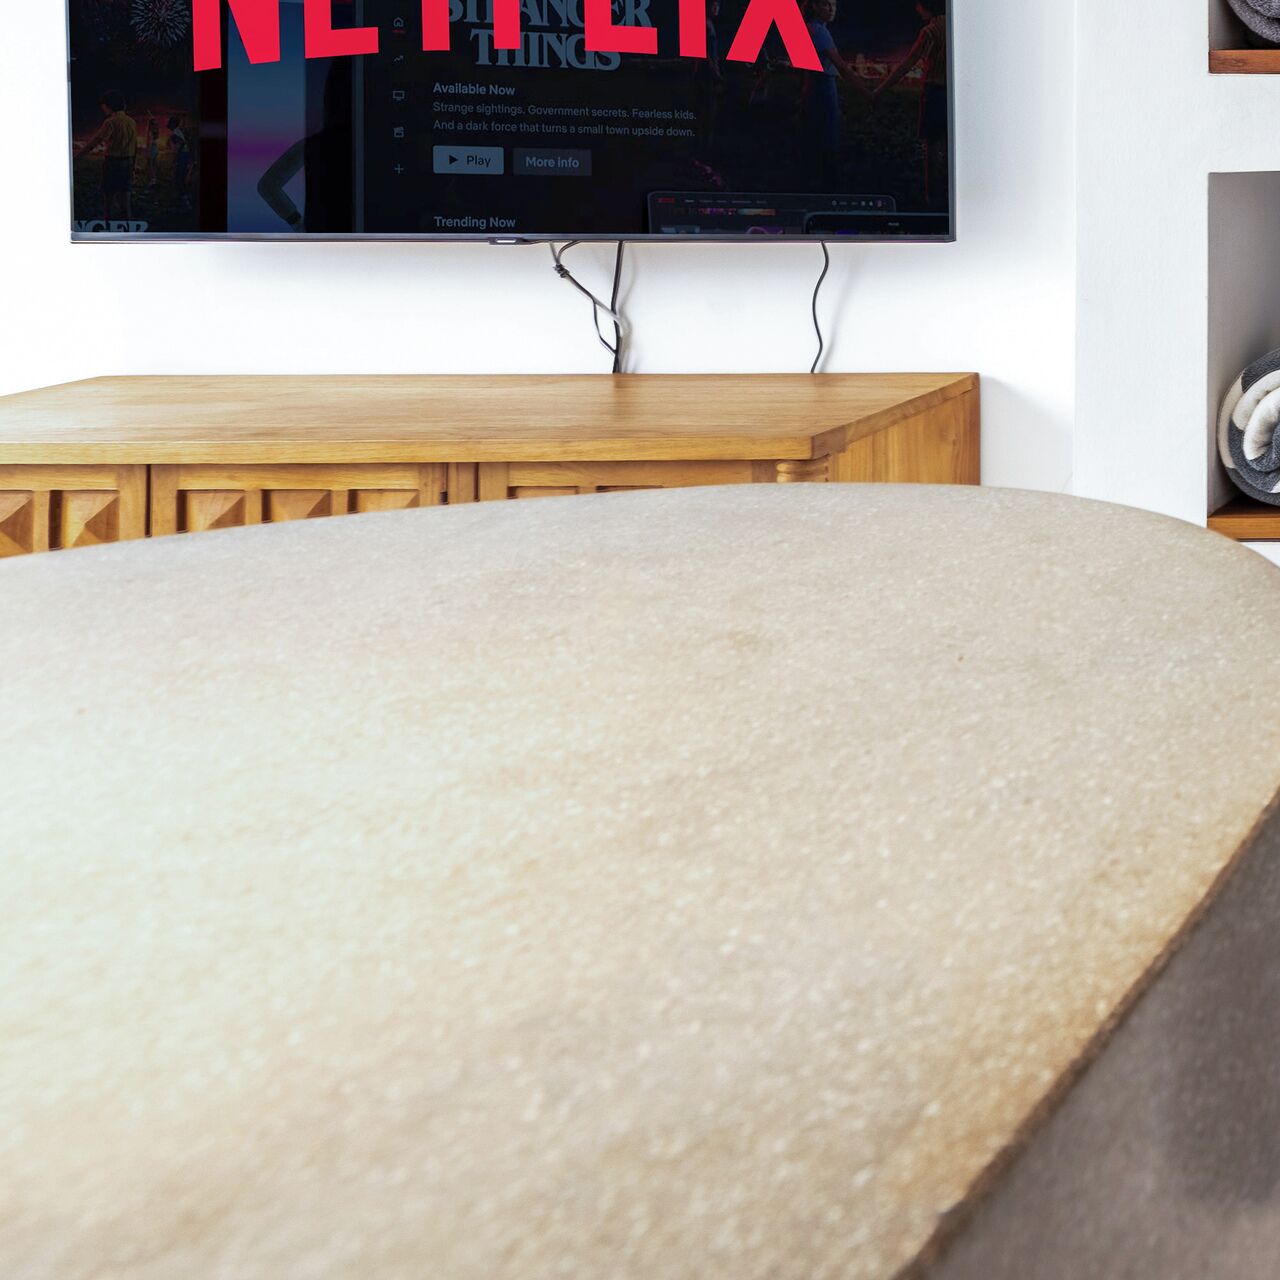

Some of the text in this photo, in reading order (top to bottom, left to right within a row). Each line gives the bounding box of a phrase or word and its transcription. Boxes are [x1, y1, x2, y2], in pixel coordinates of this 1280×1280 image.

[432, 82, 516, 96] Available Now
[432, 101, 697, 120] Strange sightings. Government secrets. Fearless kids.
[433, 119, 696, 137] And a dark force that turns a small town upside down.
[466, 155, 491, 168] Play
[525, 156, 580, 169] More info
[433, 216, 516, 230] Trending Now
